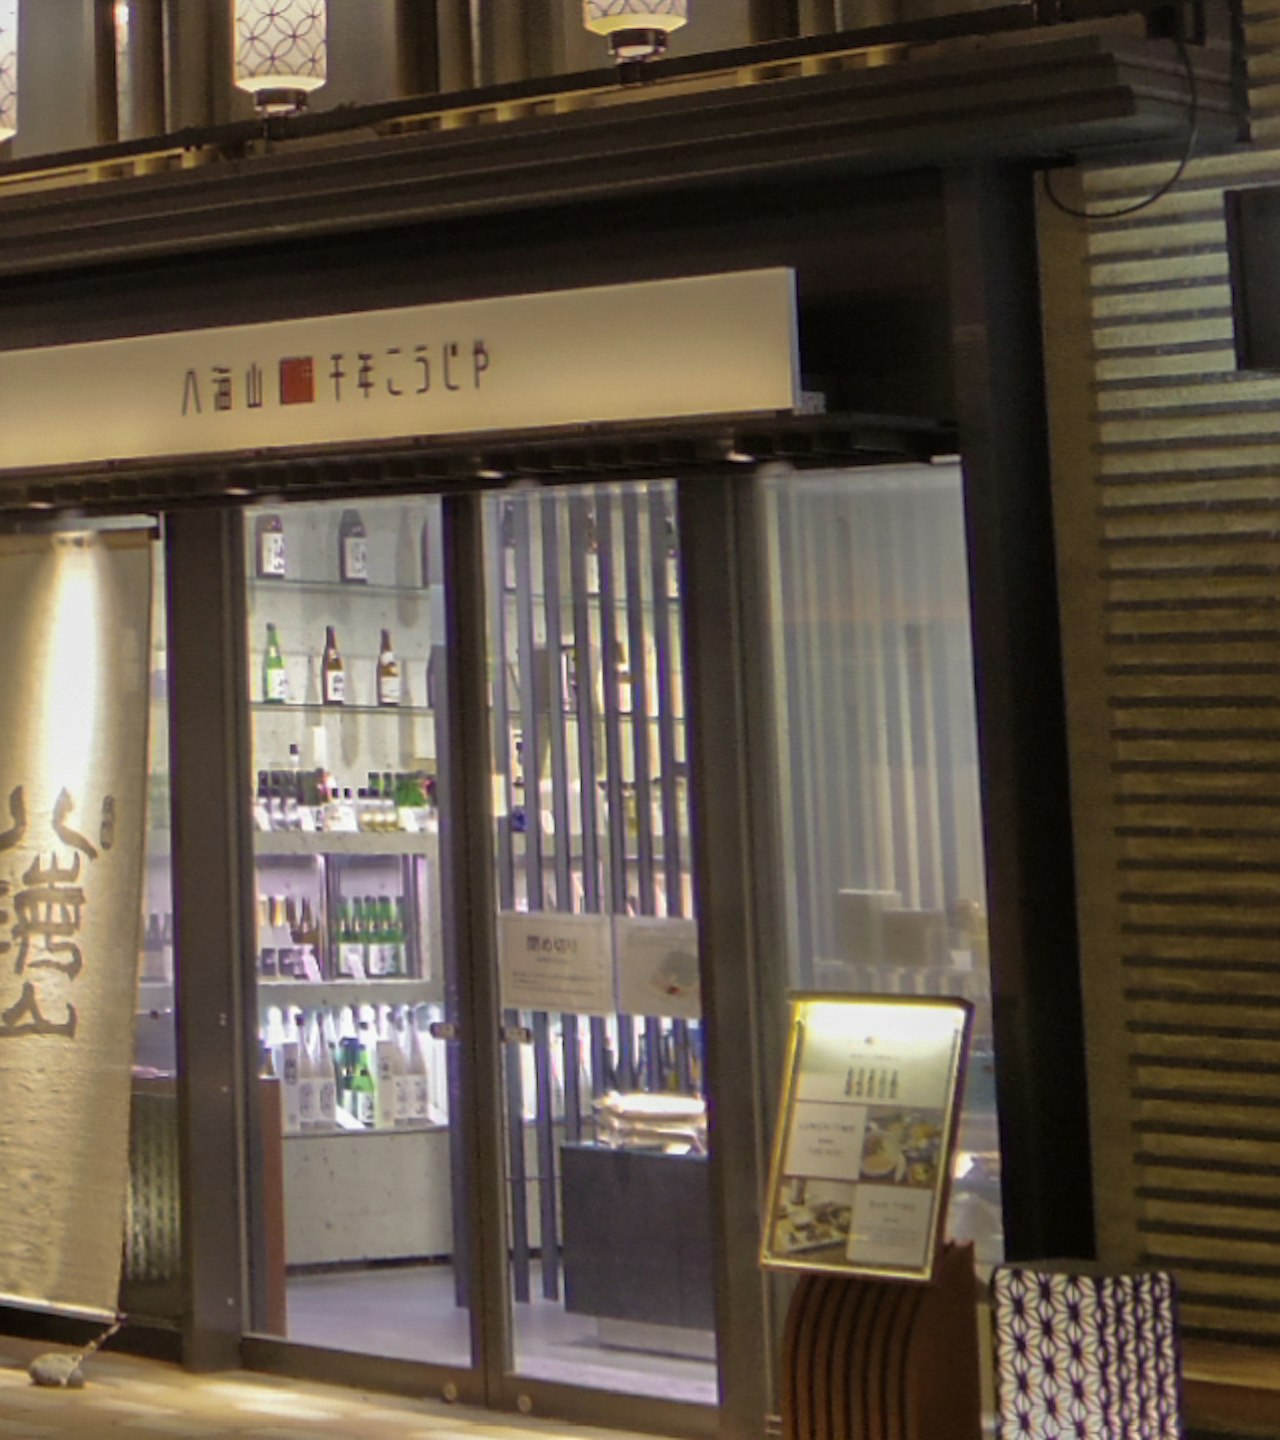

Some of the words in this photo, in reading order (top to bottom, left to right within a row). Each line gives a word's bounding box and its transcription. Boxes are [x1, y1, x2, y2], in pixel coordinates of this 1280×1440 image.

[329, 339, 490, 402] 千年こうじや
